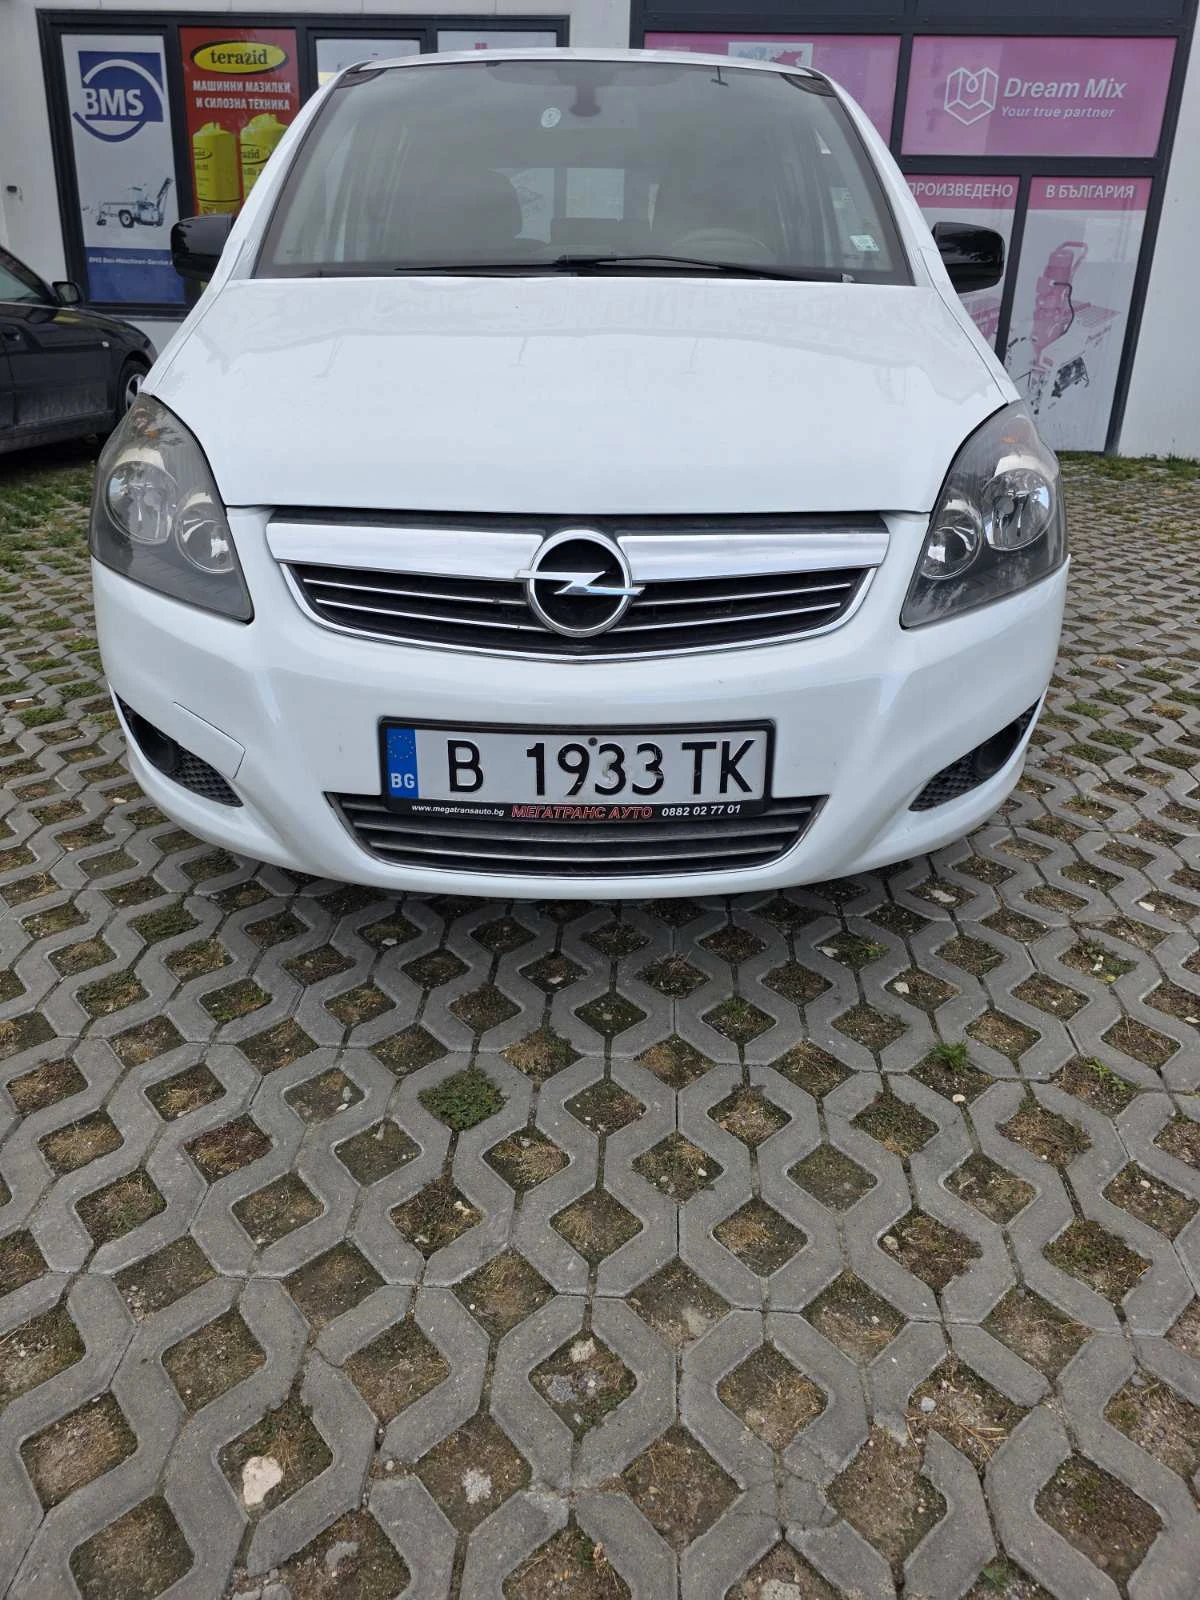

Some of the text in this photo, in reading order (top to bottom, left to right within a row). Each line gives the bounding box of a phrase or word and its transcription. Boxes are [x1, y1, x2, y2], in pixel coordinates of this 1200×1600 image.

[210, 49, 268, 65] terazid
[193, 80, 290, 93] МАШИННИ МАЗИЛКИ
[1004, 77, 1127, 98] Dream Mix
[81, 88, 144, 116] BMS
[196, 98, 290, 110] И СИЛОЗНА ТЕХНИКА
[1001, 106, 1115, 119] Your true partner
[908, 182, 1014, 199] ПРОИЗВЕДЕНО
[1046, 183, 1136, 199] В БЪЛГАРИЯ
[448, 739, 757, 796] B 1933 TK
[391, 773, 415, 789] BG
[411, 804, 505, 817] www.megatransauto.bg
[511, 805, 653, 819] МЕГАТРАНС АУТО
[661, 804, 741, 817] 0882 02 77 01
